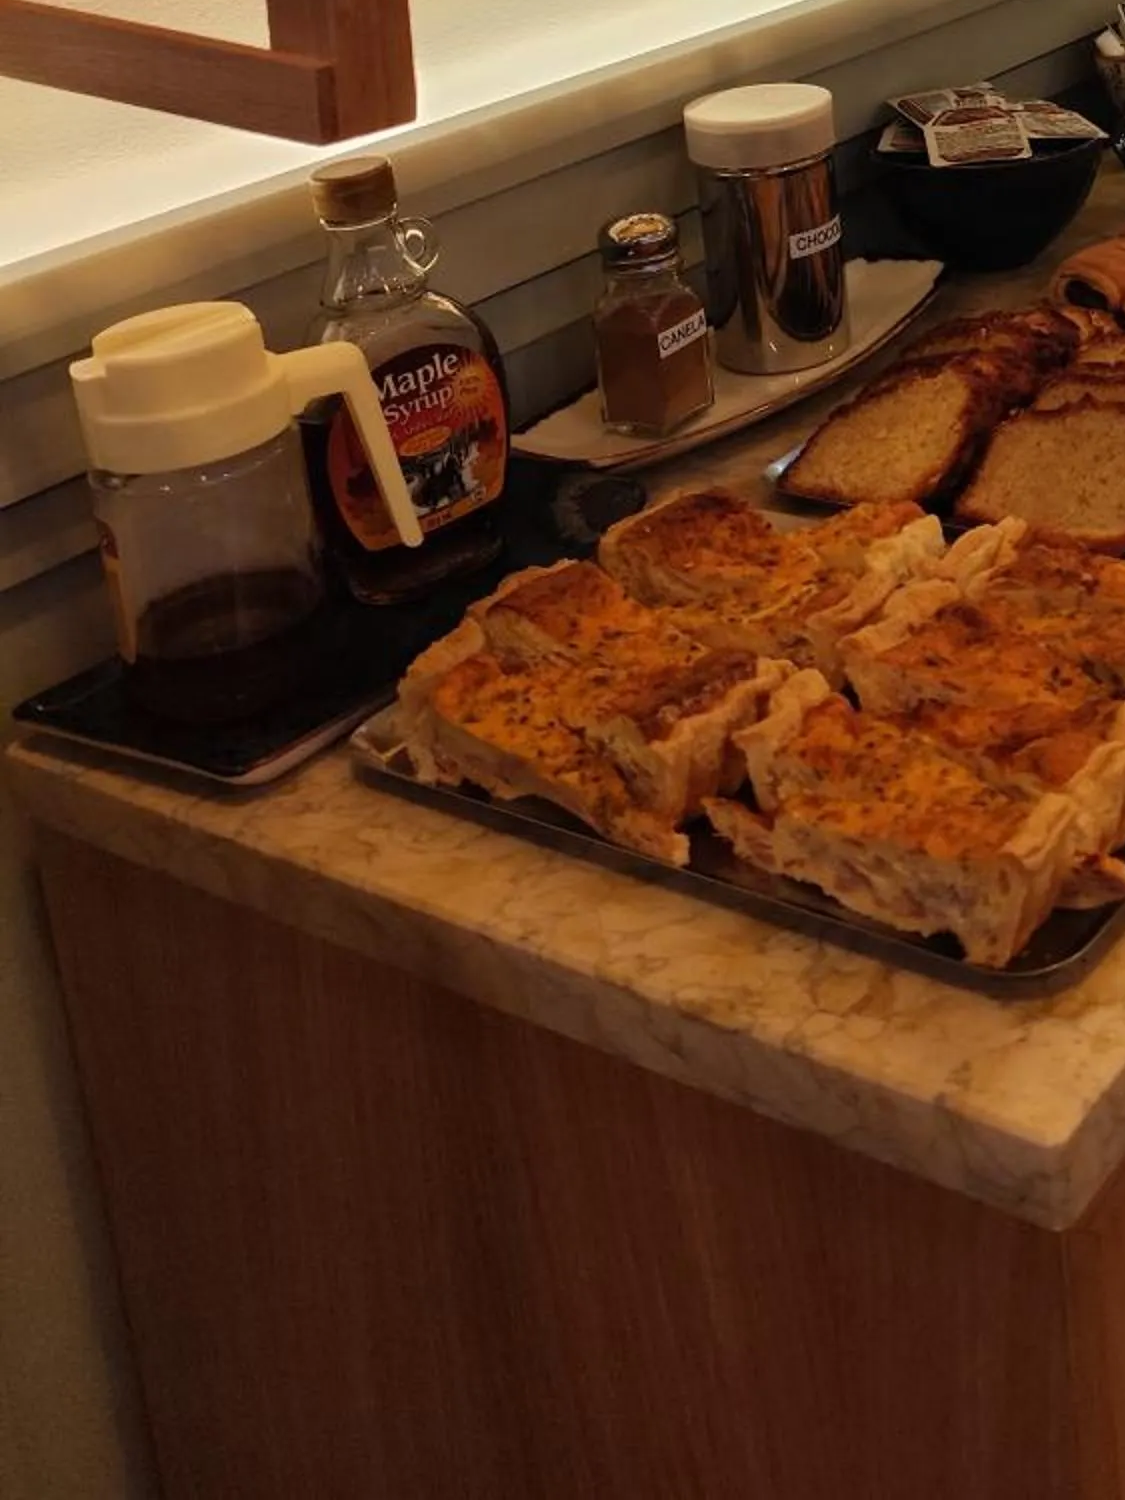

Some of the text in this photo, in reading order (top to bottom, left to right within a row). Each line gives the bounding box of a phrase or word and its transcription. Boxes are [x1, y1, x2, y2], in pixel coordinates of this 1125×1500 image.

[796, 221, 841, 251] CHOCO
[660, 315, 705, 351] CANELA
[379, 353, 459, 400] Maple
